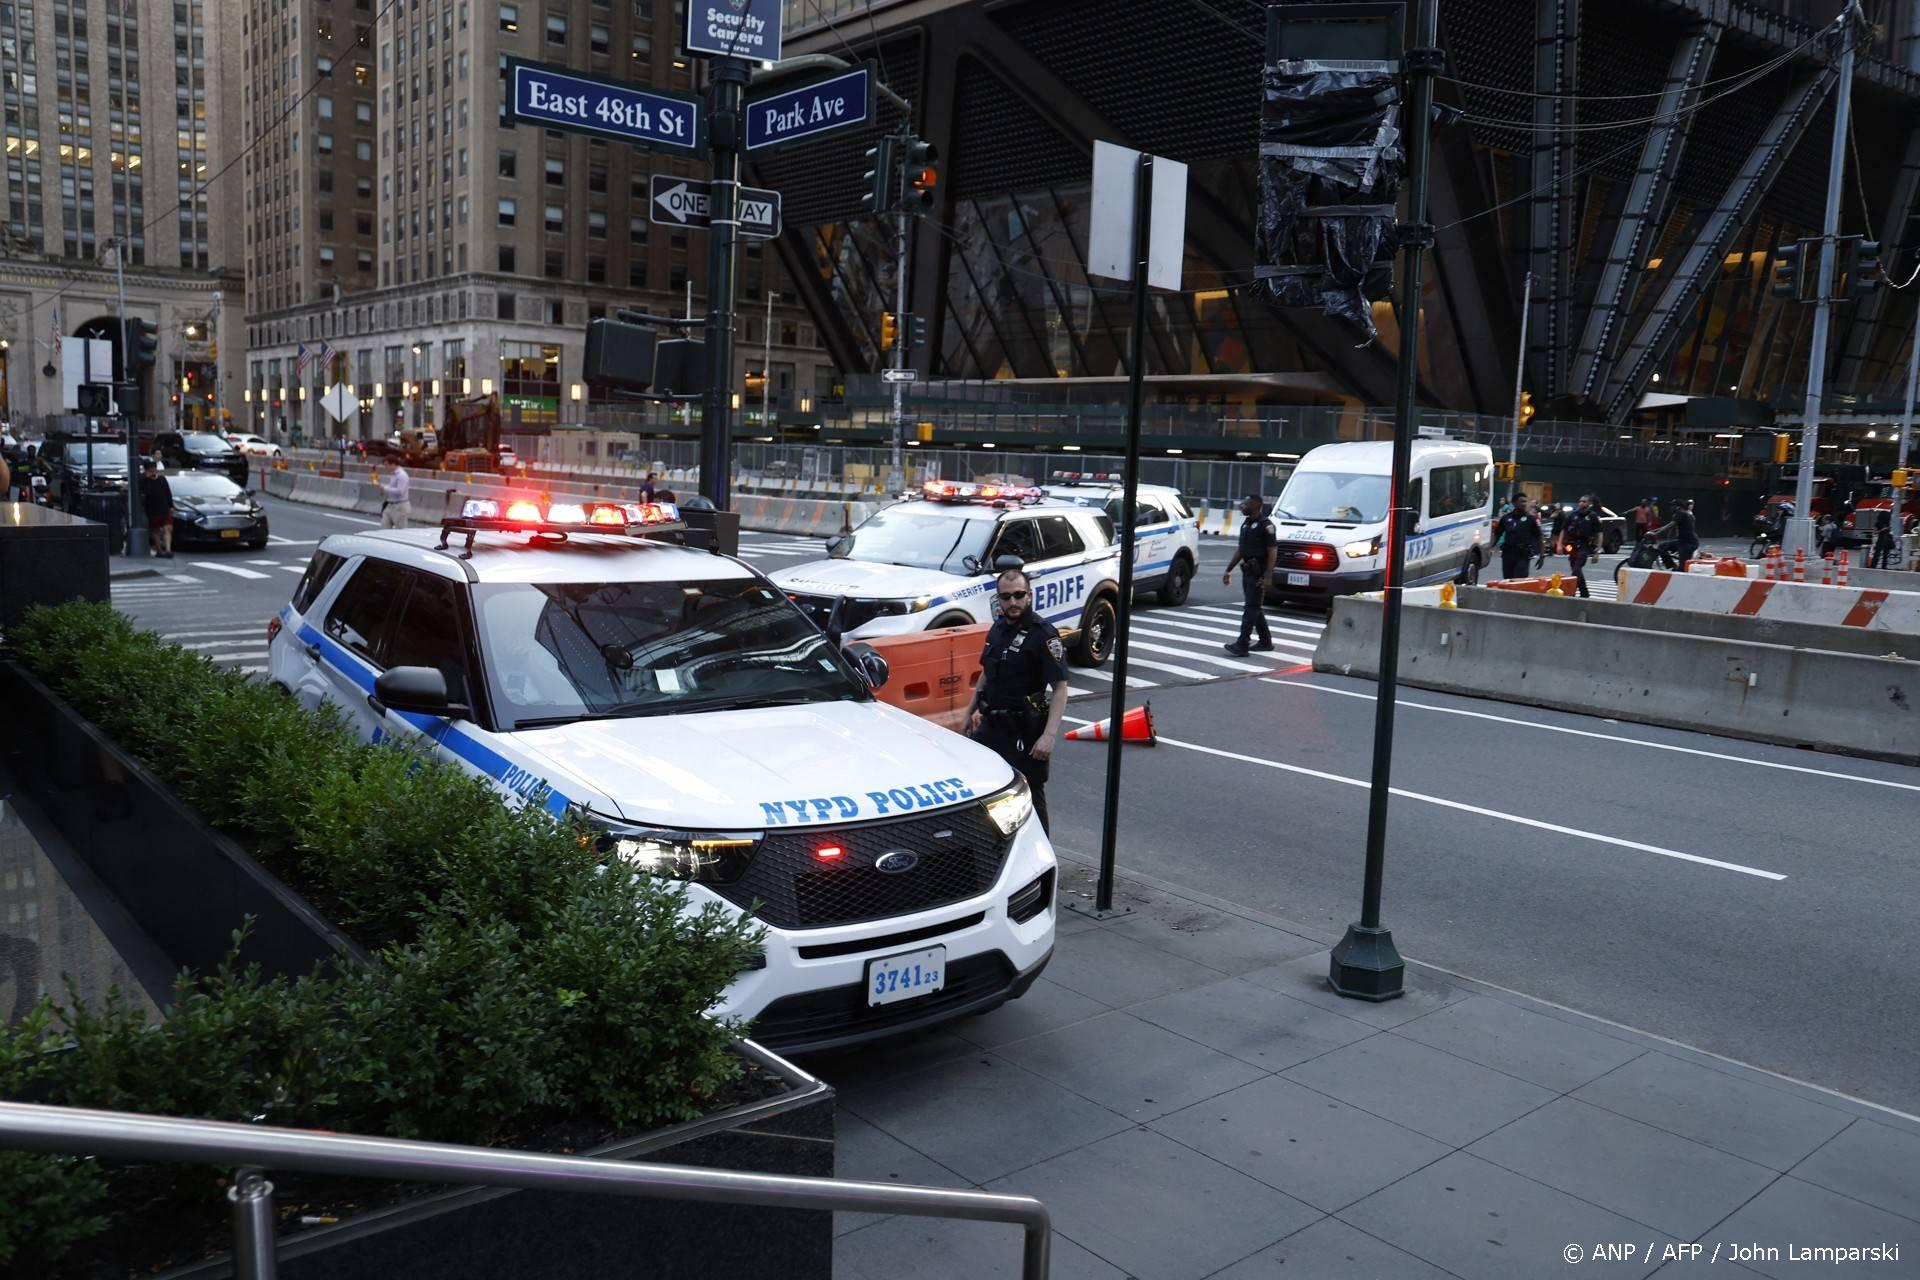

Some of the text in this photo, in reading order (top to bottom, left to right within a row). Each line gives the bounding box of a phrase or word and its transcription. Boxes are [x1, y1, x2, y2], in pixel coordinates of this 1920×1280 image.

[708, 24, 763, 46] Camera
[528, 80, 684, 137] East 48th St
[765, 96, 845, 135] Park Ave
[670, 193, 768, 221] ONE AY
[952, 584, 984, 601] SHERIFF
[1035, 575, 1085, 611] ERIFF
[760, 777, 975, 825] NYPD POLICE
[875, 964, 922, 995] 3741
